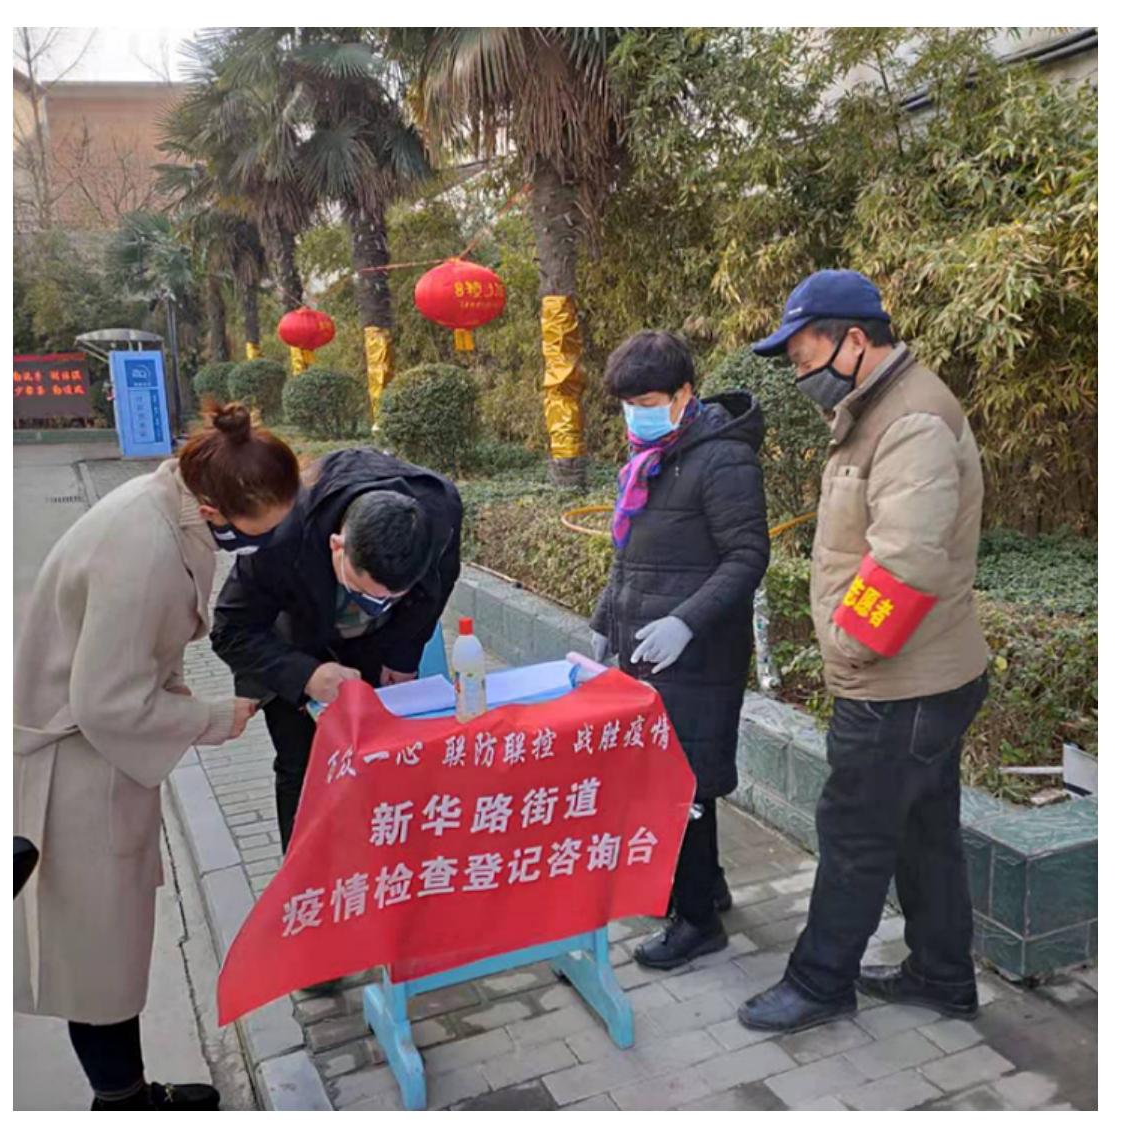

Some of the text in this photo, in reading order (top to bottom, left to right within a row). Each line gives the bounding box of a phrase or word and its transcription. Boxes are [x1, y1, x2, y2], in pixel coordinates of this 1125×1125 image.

[843, 576, 894, 628] 志愿者
[441, 729, 556, 768] 联防联控
[572, 714, 671, 755] 战胜疫情
[369, 777, 602, 847] 新华路街道
[280, 827, 658, 937] 疫情检查登记咨询台
